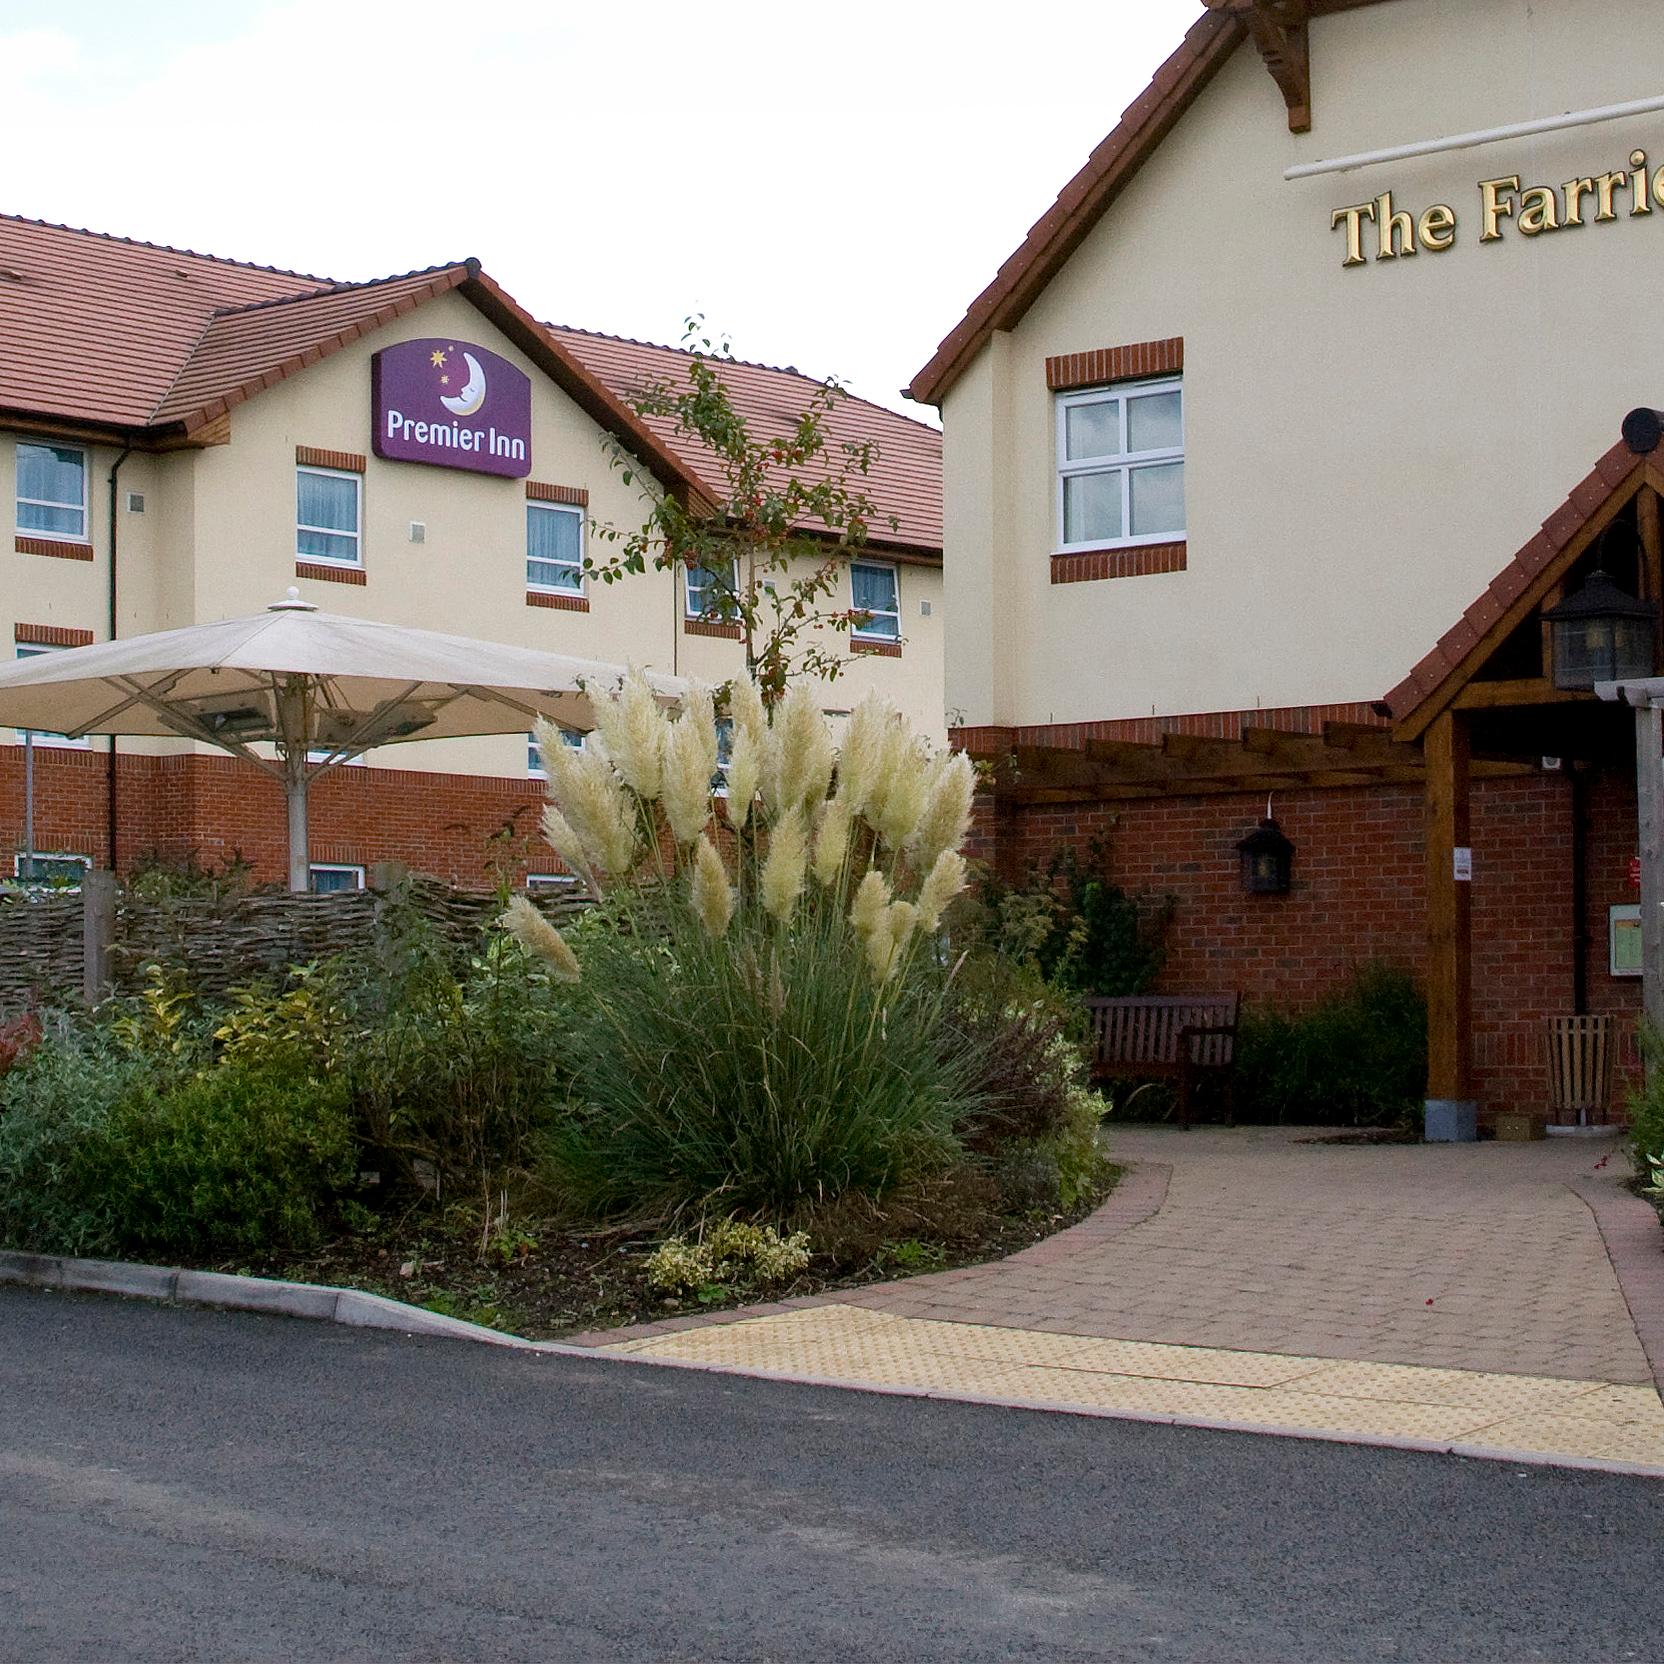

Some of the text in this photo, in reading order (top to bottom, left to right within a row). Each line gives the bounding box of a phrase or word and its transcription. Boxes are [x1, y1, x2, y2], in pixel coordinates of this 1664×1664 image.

[1330, 190, 1457, 267] The
[387, 410, 526, 460] Premier Inn
